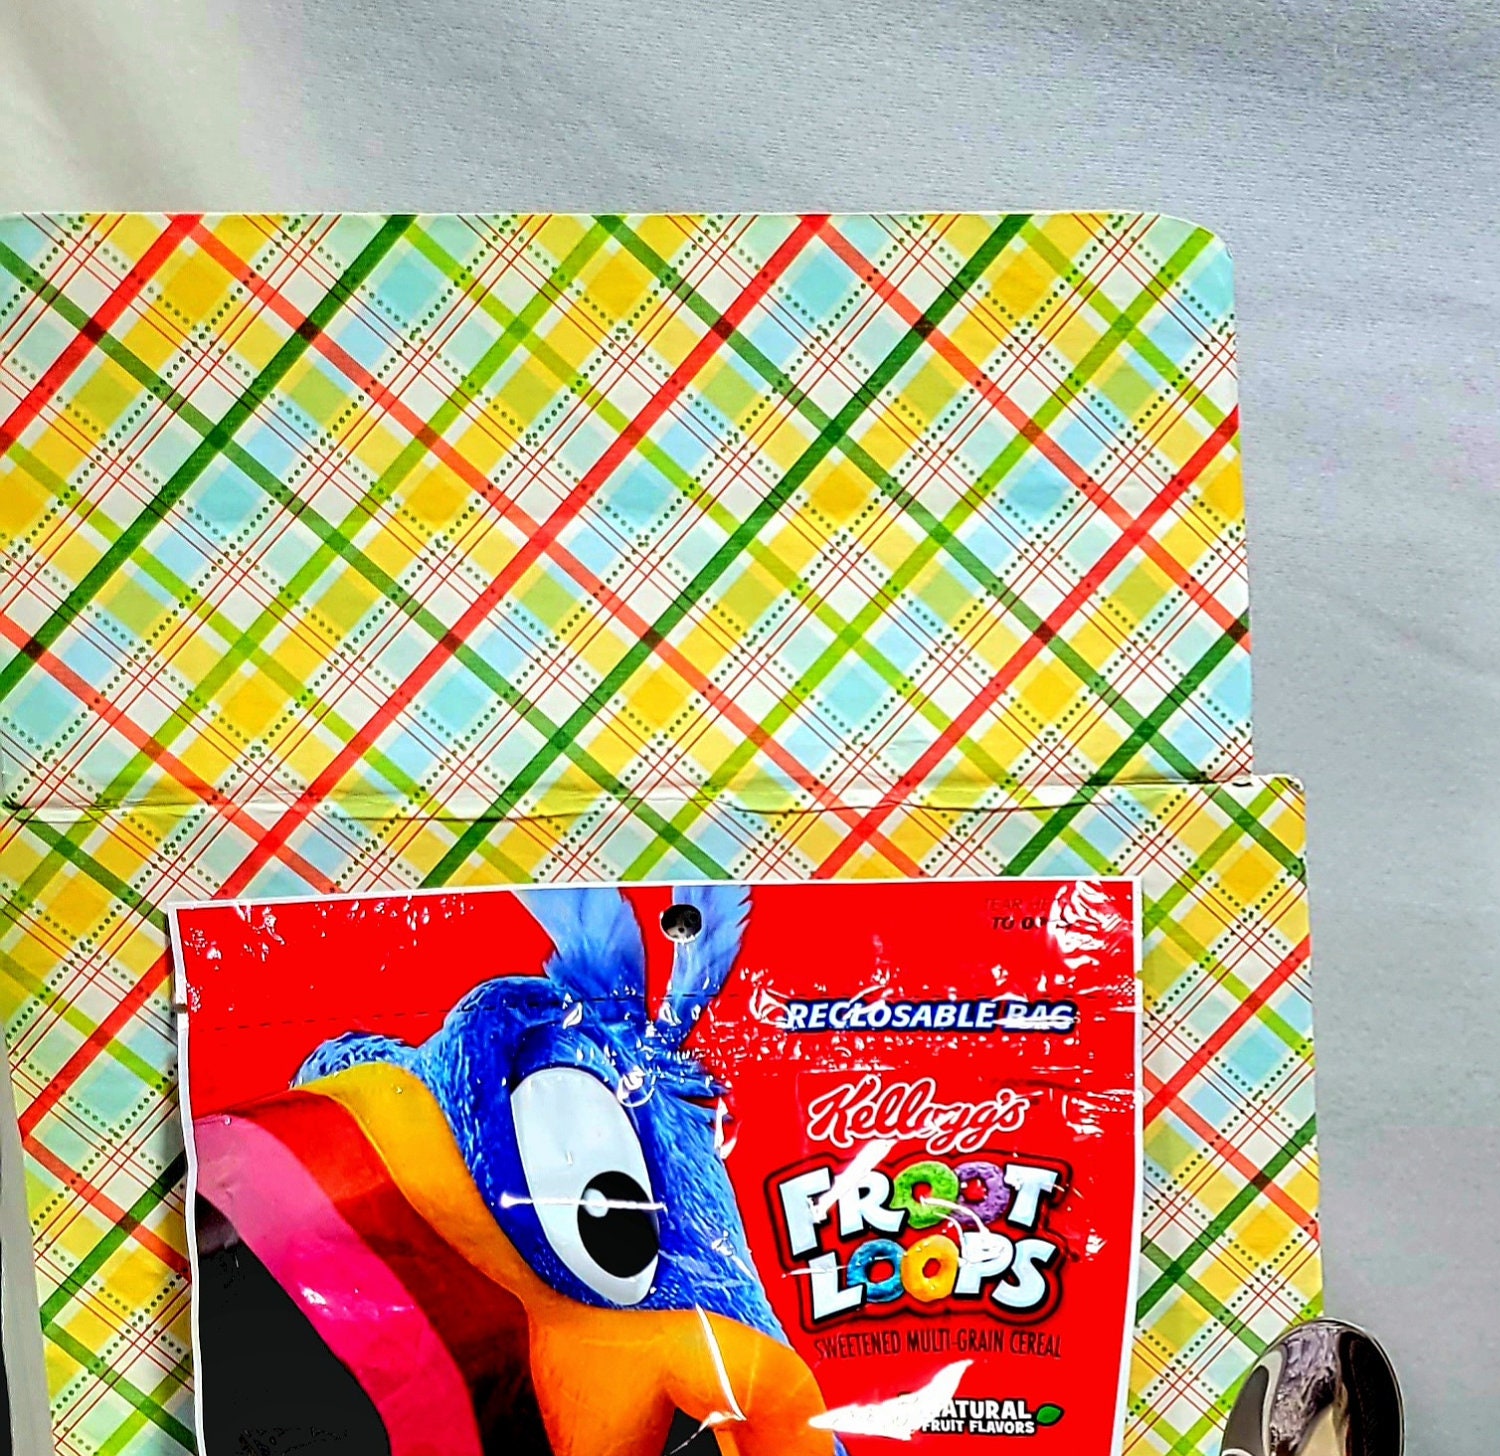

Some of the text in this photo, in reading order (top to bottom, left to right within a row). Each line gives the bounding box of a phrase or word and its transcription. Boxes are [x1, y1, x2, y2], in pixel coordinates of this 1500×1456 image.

[787, 1000, 1074, 1031] RECLOSABLE BAG
[807, 1074, 1031, 1155] Kellogg's
[779, 1161, 1057, 1256] FROOT
[810, 1232, 1055, 1323] LOOPS
[814, 1329, 1062, 1360] SWEETENED MULTI-GRAIN CEREAL
[933, 1399, 1032, 1420] ATURAL
[922, 1420, 1036, 1434] FRUIT FLAVORS
